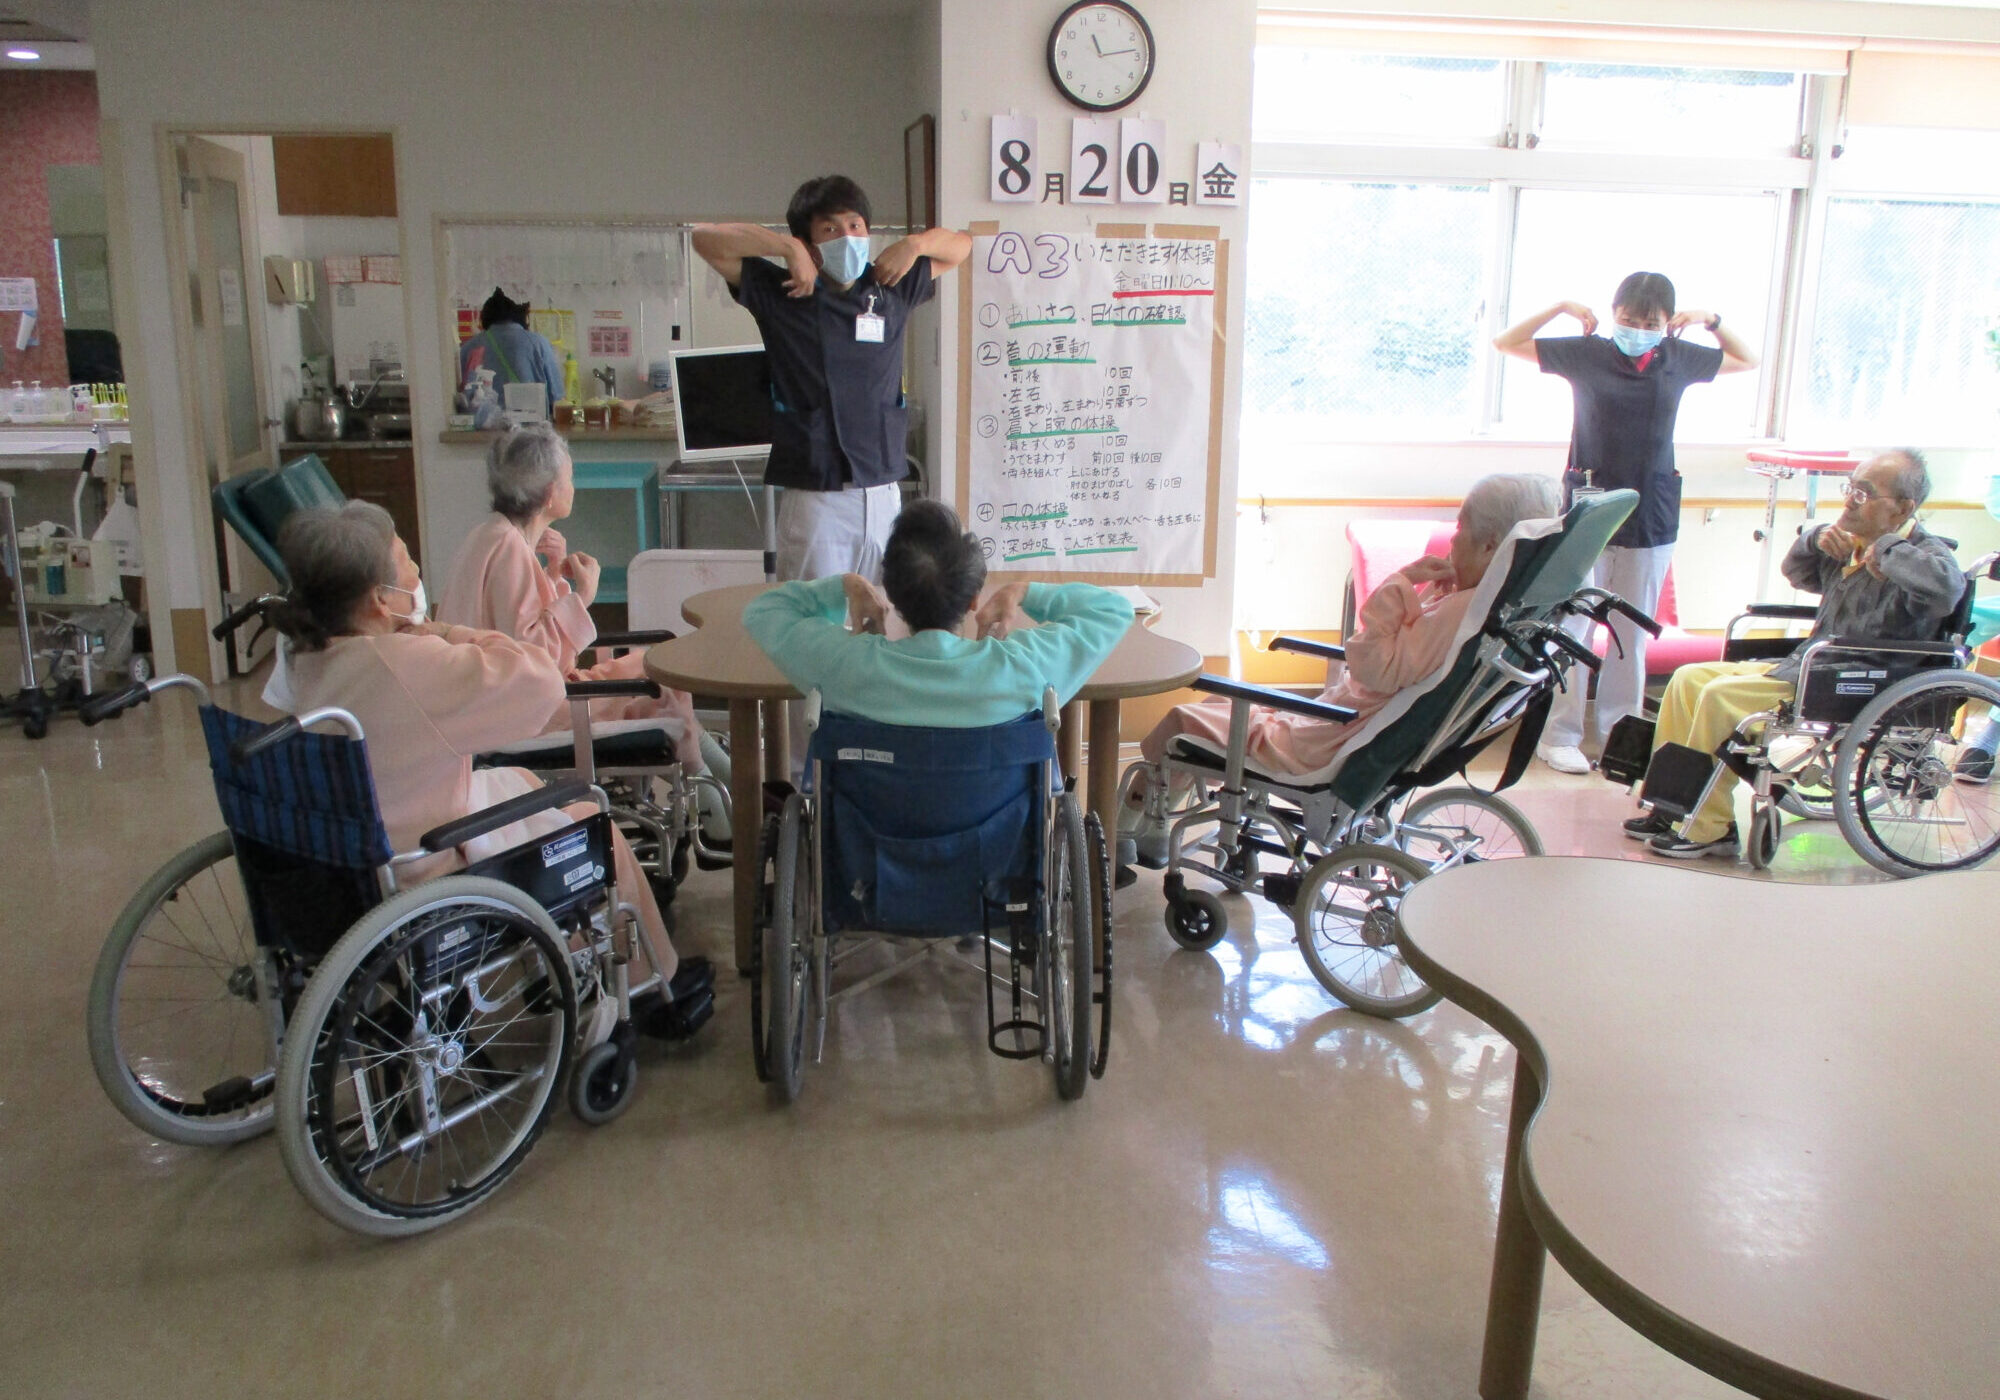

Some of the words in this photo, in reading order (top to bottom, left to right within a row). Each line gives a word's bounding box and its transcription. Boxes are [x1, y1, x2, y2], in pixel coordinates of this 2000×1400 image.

[1080, 17, 1087, 26] 11
[1097, 13, 1106, 22] 12
[1066, 30, 1076, 40] 10
[1129, 32, 1136, 41] 2
[1061, 50, 1068, 59] 9
[1134, 52, 1141, 61] 3
[1066, 71, 1073, 80] 8
[1128, 72, 1134, 80] 4
[1080, 84, 1087, 93] 7
[1115, 85, 1121, 94] 5
[1097, 90, 1104, 98] 6
[1104, 366, 1133, 379] 10回
[1102, 384, 1131, 397] 10回
[1101, 434, 1128, 449] 10回
